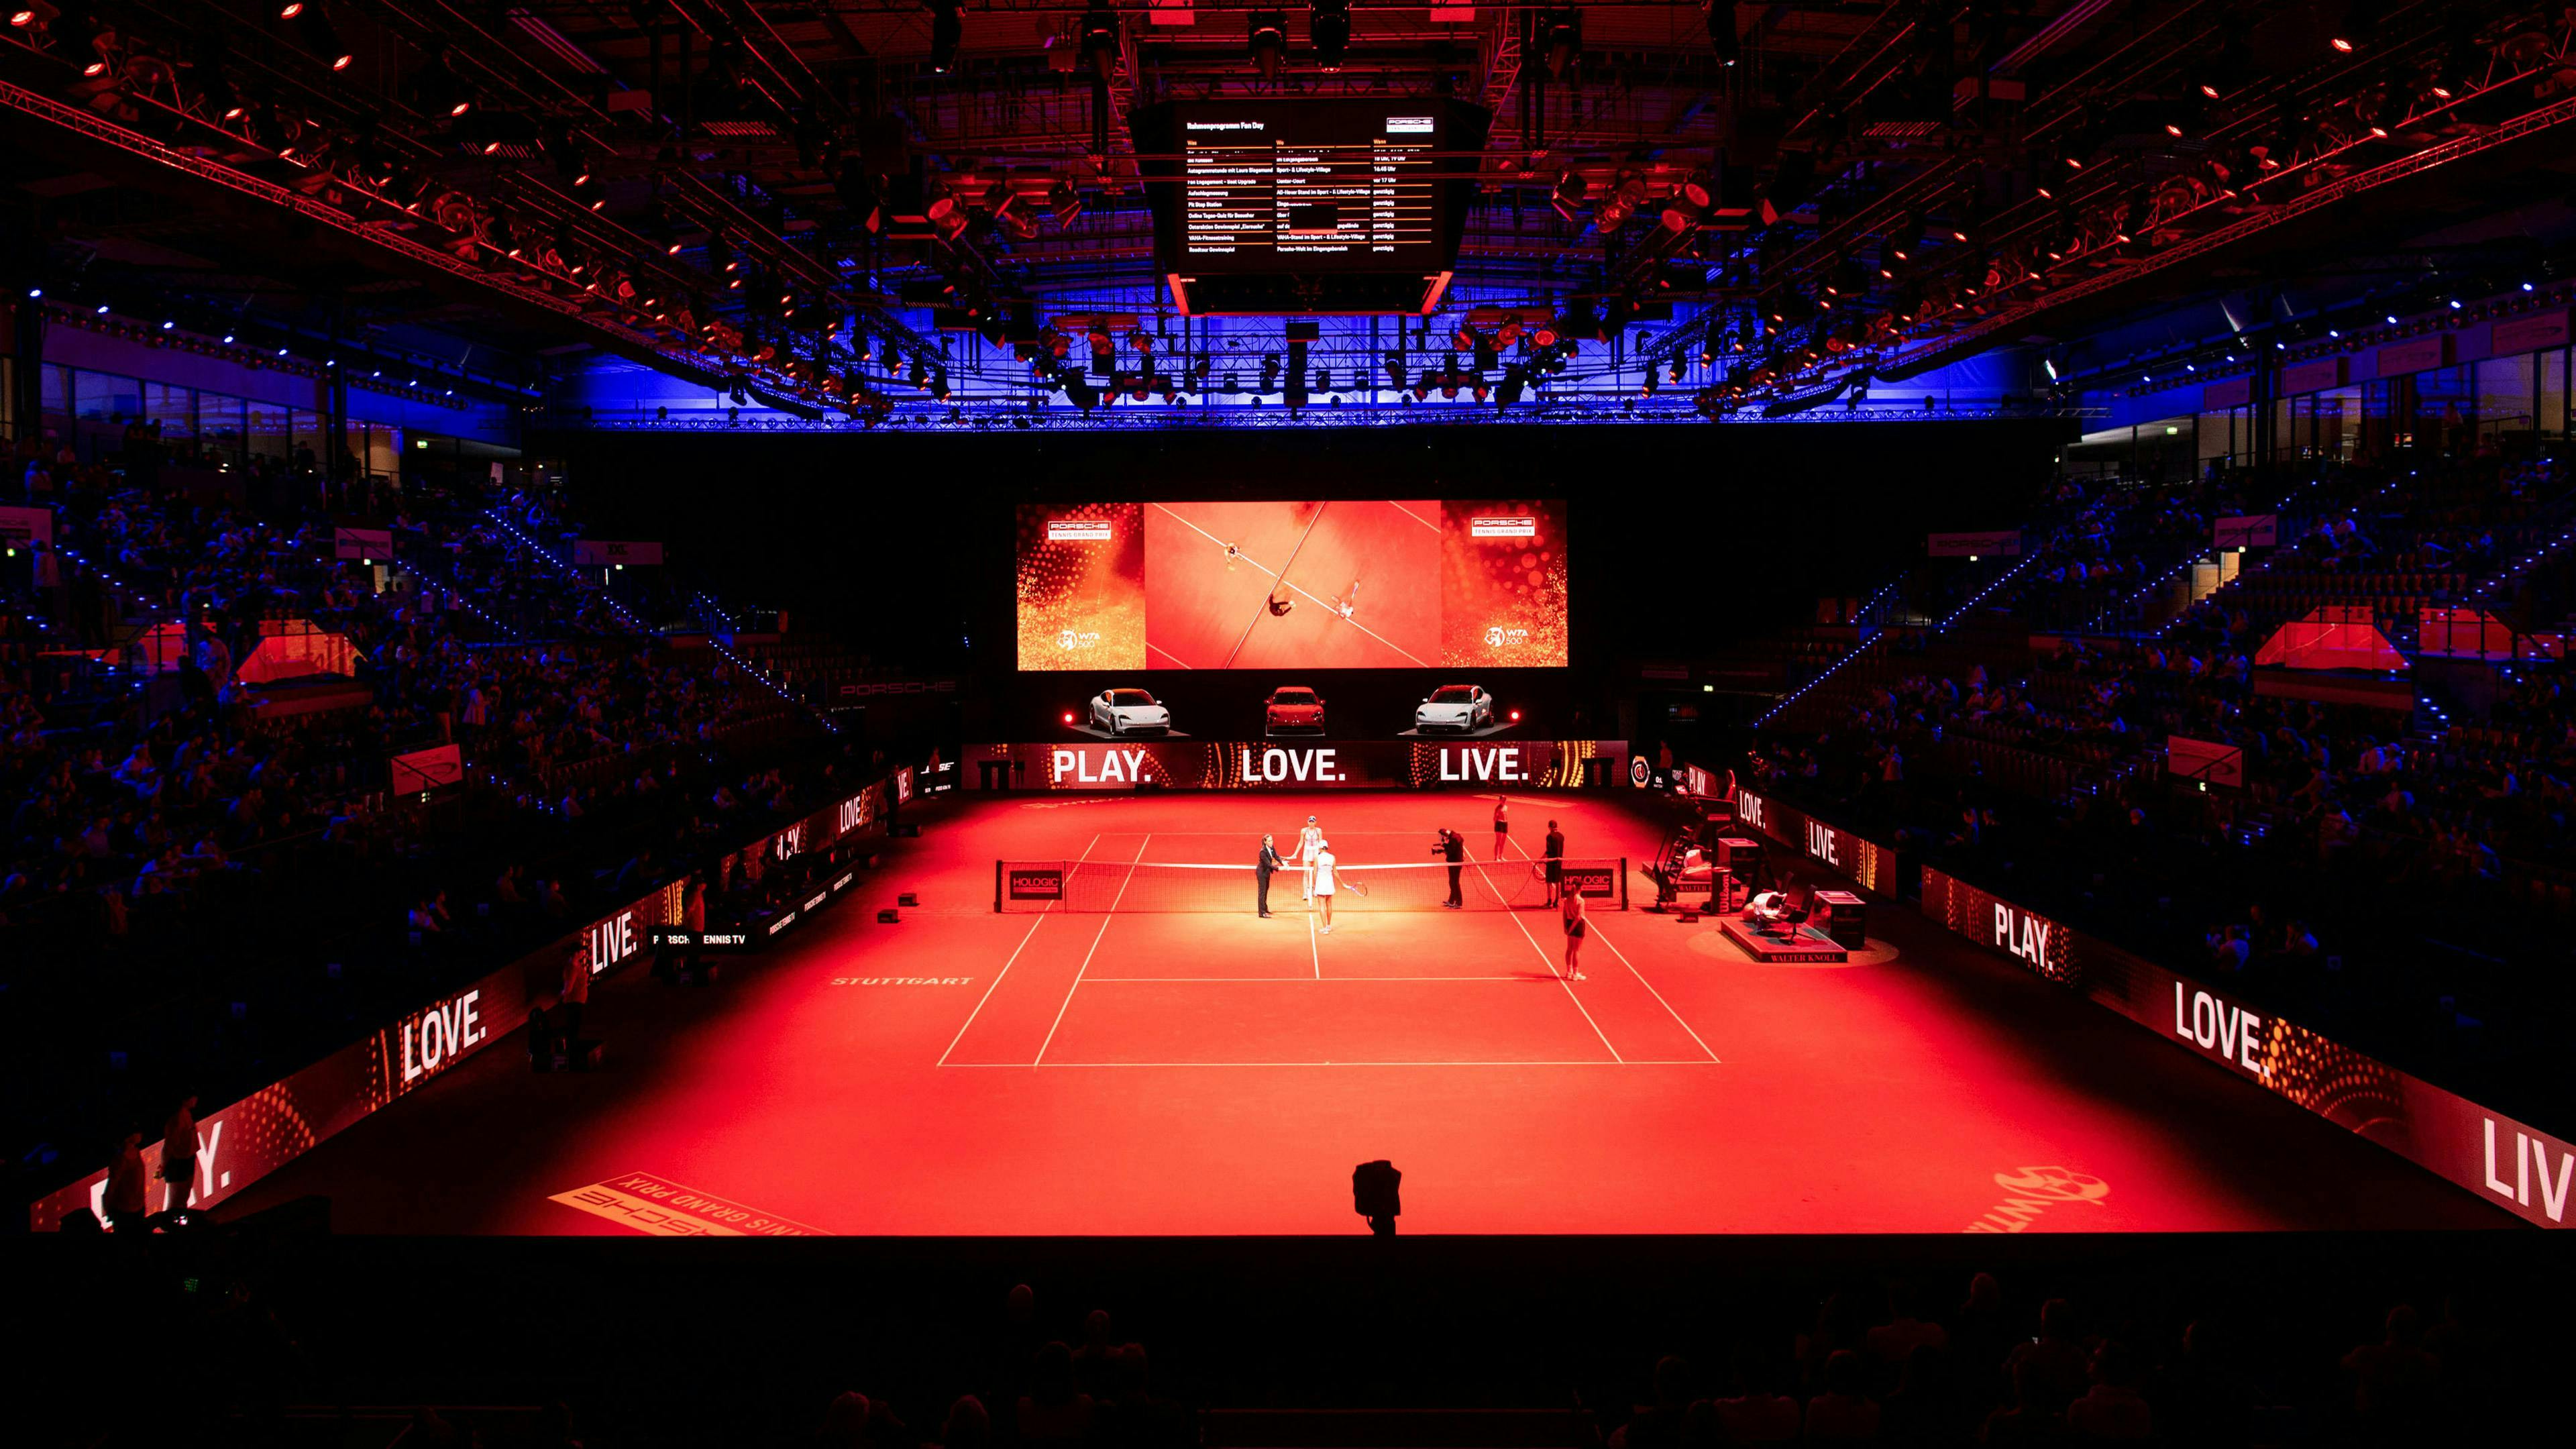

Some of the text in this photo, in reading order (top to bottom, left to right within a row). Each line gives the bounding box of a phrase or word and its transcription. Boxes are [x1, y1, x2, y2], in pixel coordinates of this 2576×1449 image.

[1252, 122, 1264, 130] Day
[840, 681, 956, 697] PORSCHE
[1054, 750, 1151, 782] PLAY.
[1242, 749, 1346, 782] LOVE.
[1440, 748, 1528, 781] LIVE.
[898, 772, 909, 800] VE.
[1739, 790, 1766, 829] LOVE.
[1810, 822, 1839, 866] LIVE.
[1014, 878, 1059, 886] HOLOGIC
[1719, 873, 1729, 913] Wilson
[592, 911, 637, 975] LIVE.
[653, 935, 745, 945] PRSCH ENNIS TV
[1995, 902, 2053, 971] PLAY.
[830, 977, 974, 985] STUTTGART
[404, 989, 486, 1082] LOVE.
[2176, 981, 2270, 1078] LOVE.
[2484, 1117, 2575, 1223] LIV
[618, 1177, 669, 1199] PRIX
[572, 1191, 708, 1236] SCHE
[671, 1195, 749, 1222] GRAND
